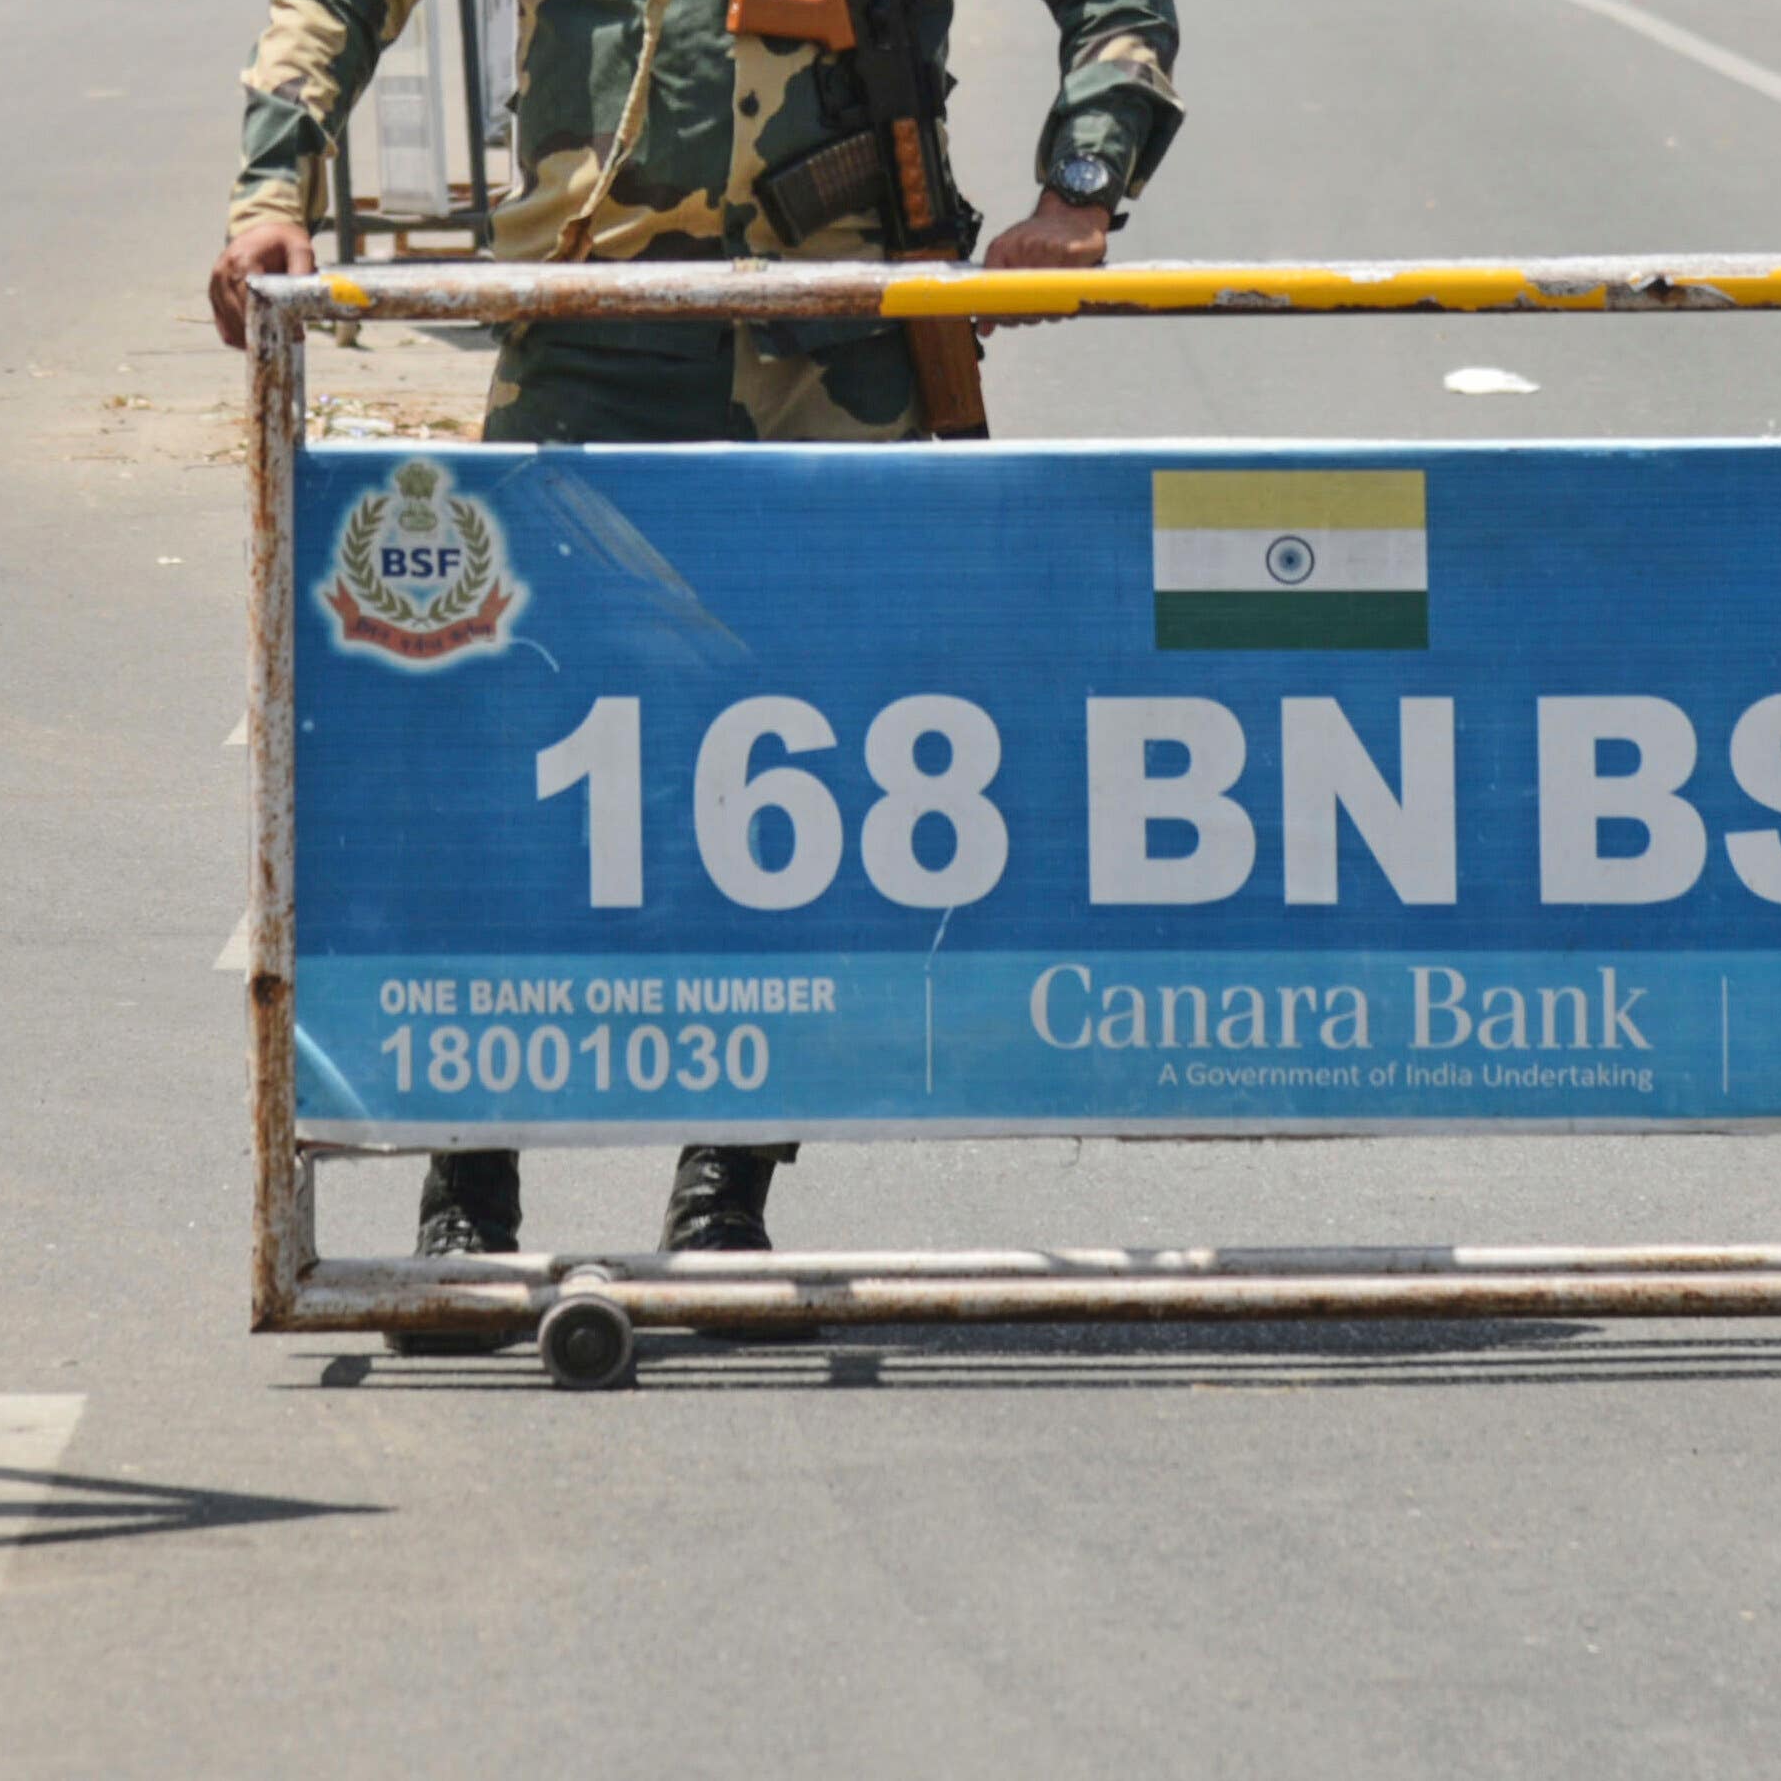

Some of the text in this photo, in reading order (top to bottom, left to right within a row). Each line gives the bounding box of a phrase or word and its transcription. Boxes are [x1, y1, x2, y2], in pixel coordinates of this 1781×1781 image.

[381, 548, 460, 577] BSF
[536, 694, 1008, 911] 168
[1086, 696, 1456, 904] BN
[380, 978, 835, 1015] ONE BANK ONE NUMBER
[1030, 964, 1652, 1050] Canara Bank
[381, 1024, 769, 1092] 18001030
[1158, 1061, 1653, 1092] A Government of India Undertaking
